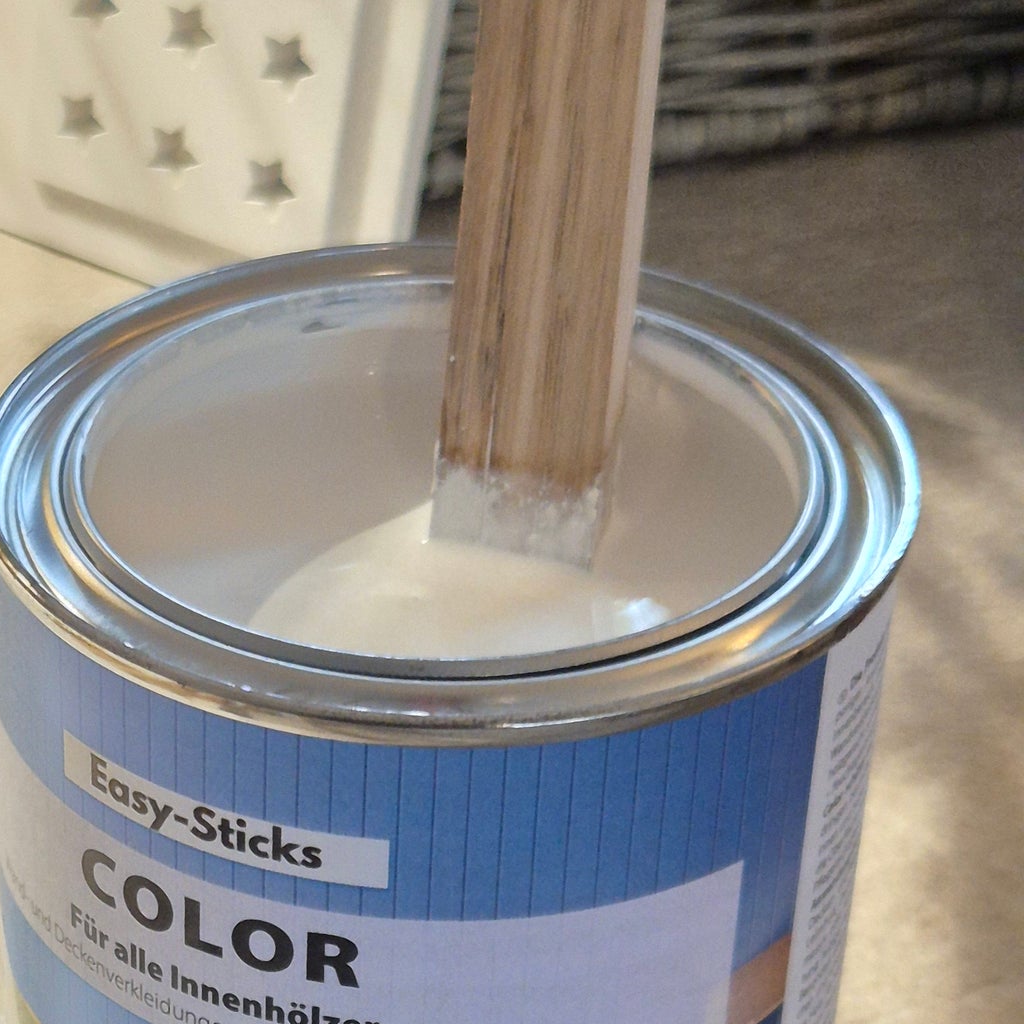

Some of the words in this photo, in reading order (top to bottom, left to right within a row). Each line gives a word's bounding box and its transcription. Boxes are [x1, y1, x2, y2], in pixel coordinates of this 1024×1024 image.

[89, 752, 323, 869] Easy-Sticks
[70, 902, 110, 950] Für
[114, 941, 164, 983] alle
[80, 847, 361, 989] COLOR
